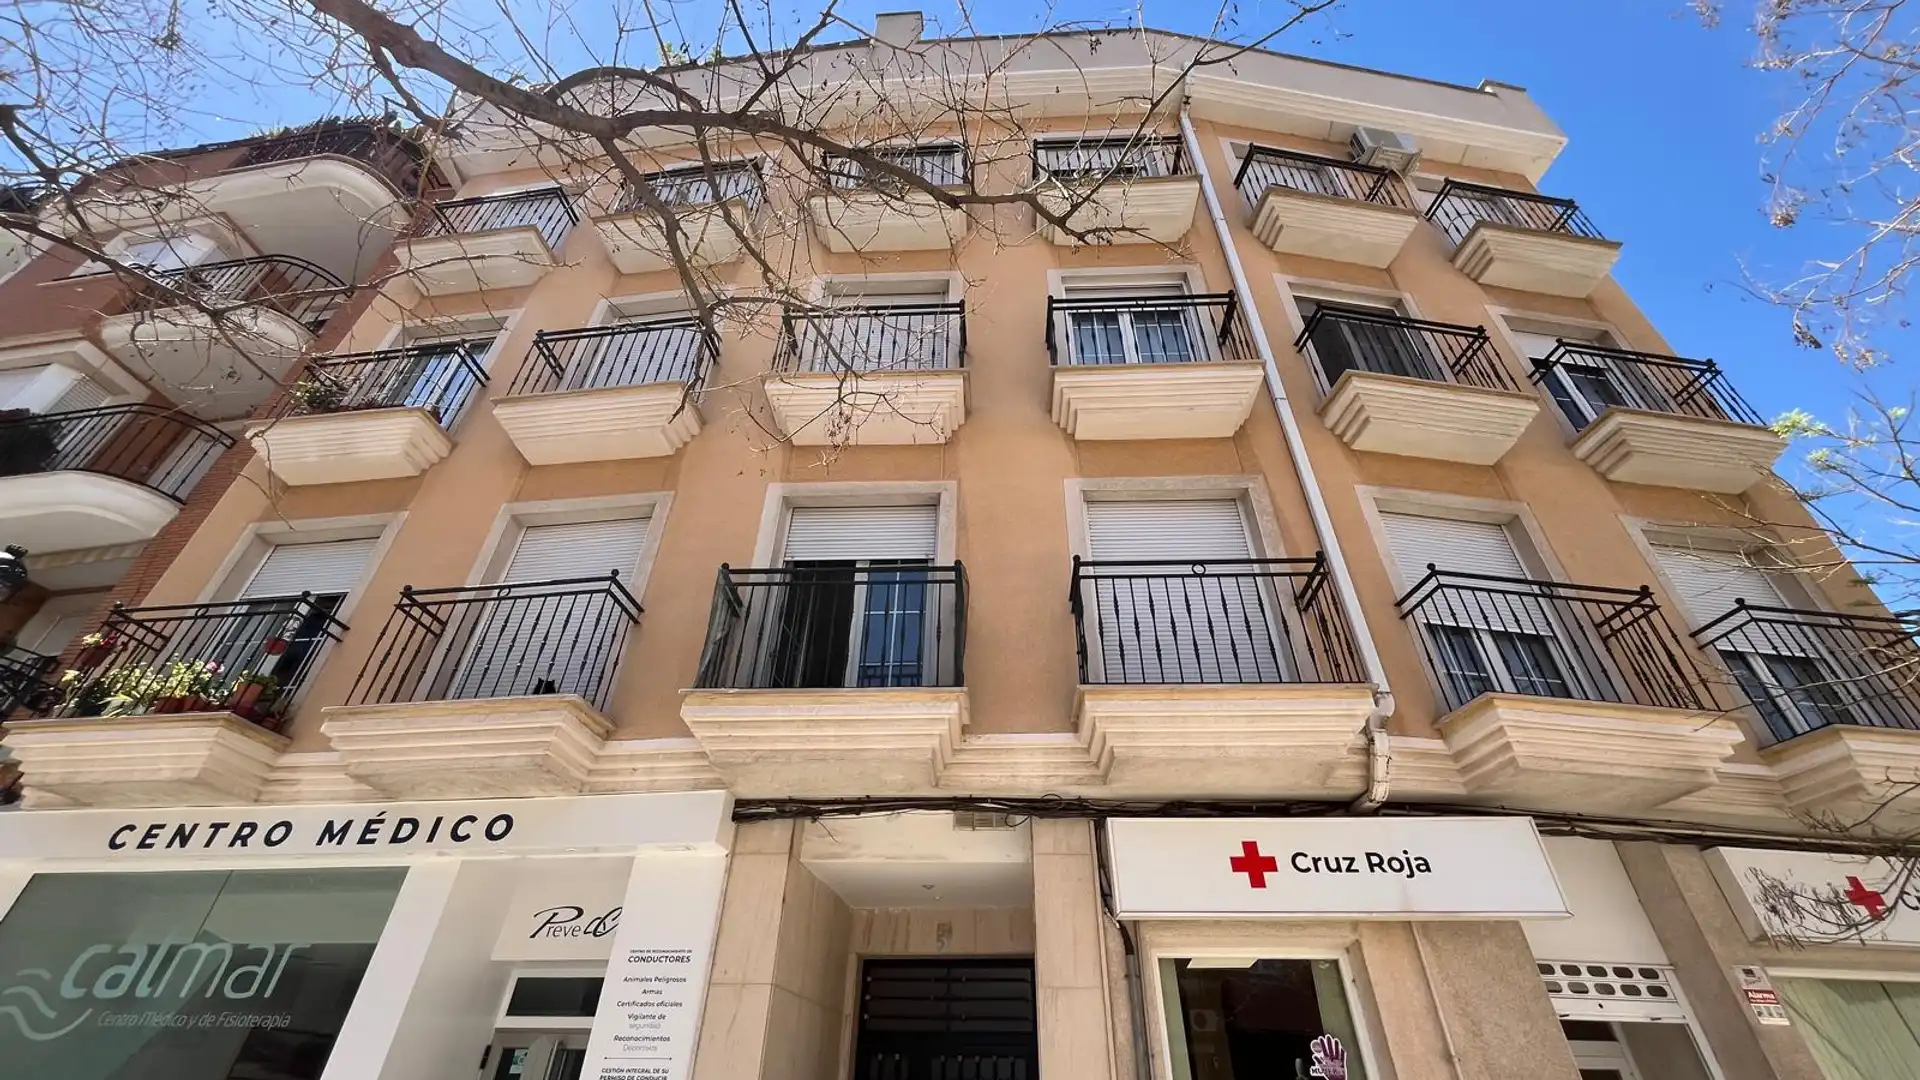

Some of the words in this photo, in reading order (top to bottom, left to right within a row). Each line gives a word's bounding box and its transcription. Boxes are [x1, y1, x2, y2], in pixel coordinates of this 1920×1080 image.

[108, 820, 294, 850] CENTRO
[315, 811, 515, 846] MÉDICO
[1291, 852, 1360, 874] Cruz
[1365, 850, 1432, 878] Roja
[628, 955, 691, 963] CONDUCTORES
[60, 931, 312, 998] calmar
[654, 976, 687, 985] Peligrosos
[1747, 990, 1777, 1000] Alarma
[98, 1011, 137, 1027] Centro
[187, 1014, 198, 1029] y
[198, 1012, 216, 1027] de
[217, 1011, 291, 1031] Fisioterapia
[628, 1013, 656, 1021] Vigilante
[614, 1034, 671, 1042] Reconocimientos
